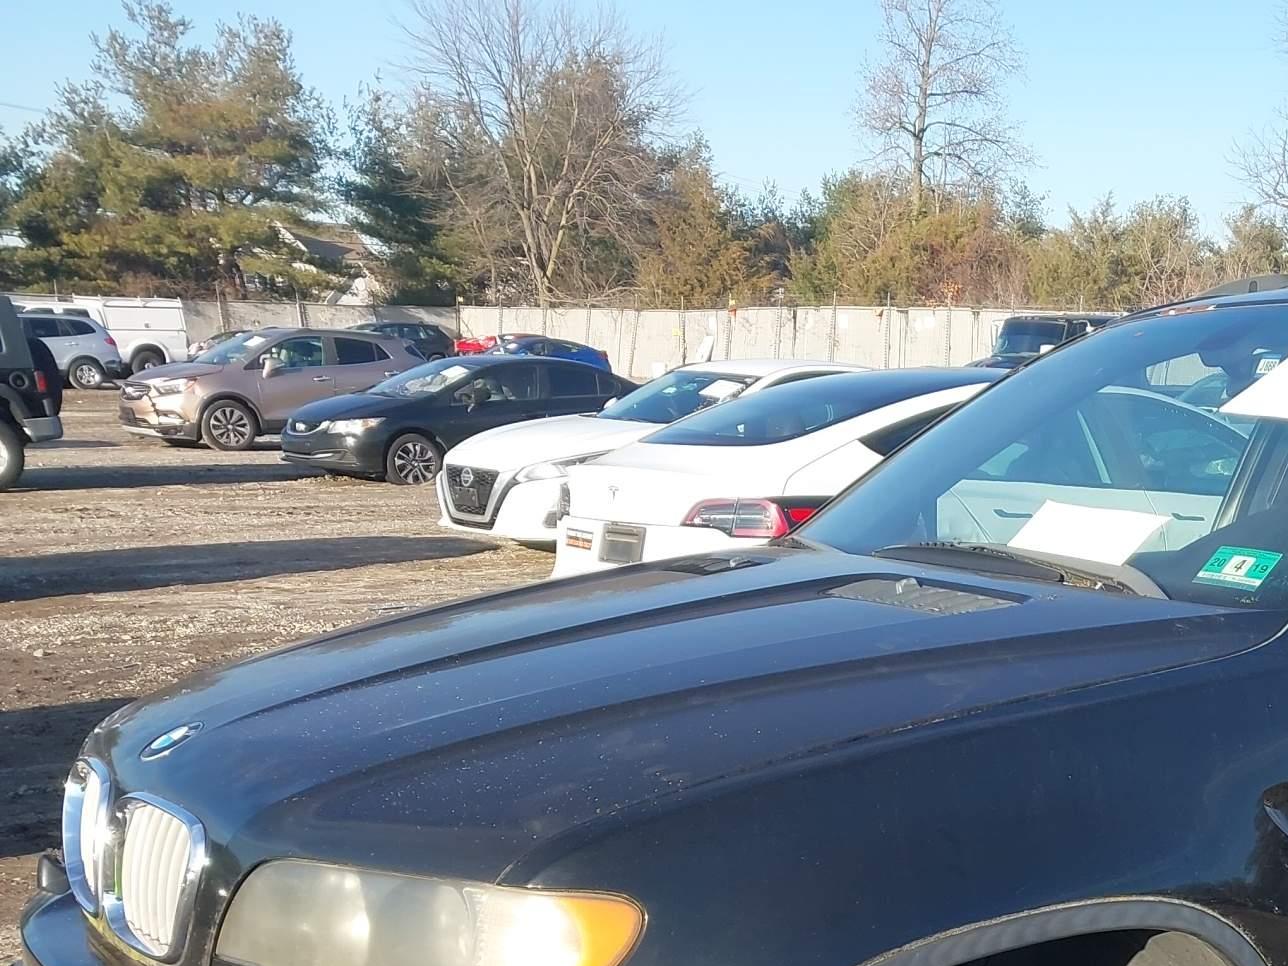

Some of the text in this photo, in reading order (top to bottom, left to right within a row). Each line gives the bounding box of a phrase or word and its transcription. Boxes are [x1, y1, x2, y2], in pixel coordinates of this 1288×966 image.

[1209, 557, 1269, 574] 20 4 19
